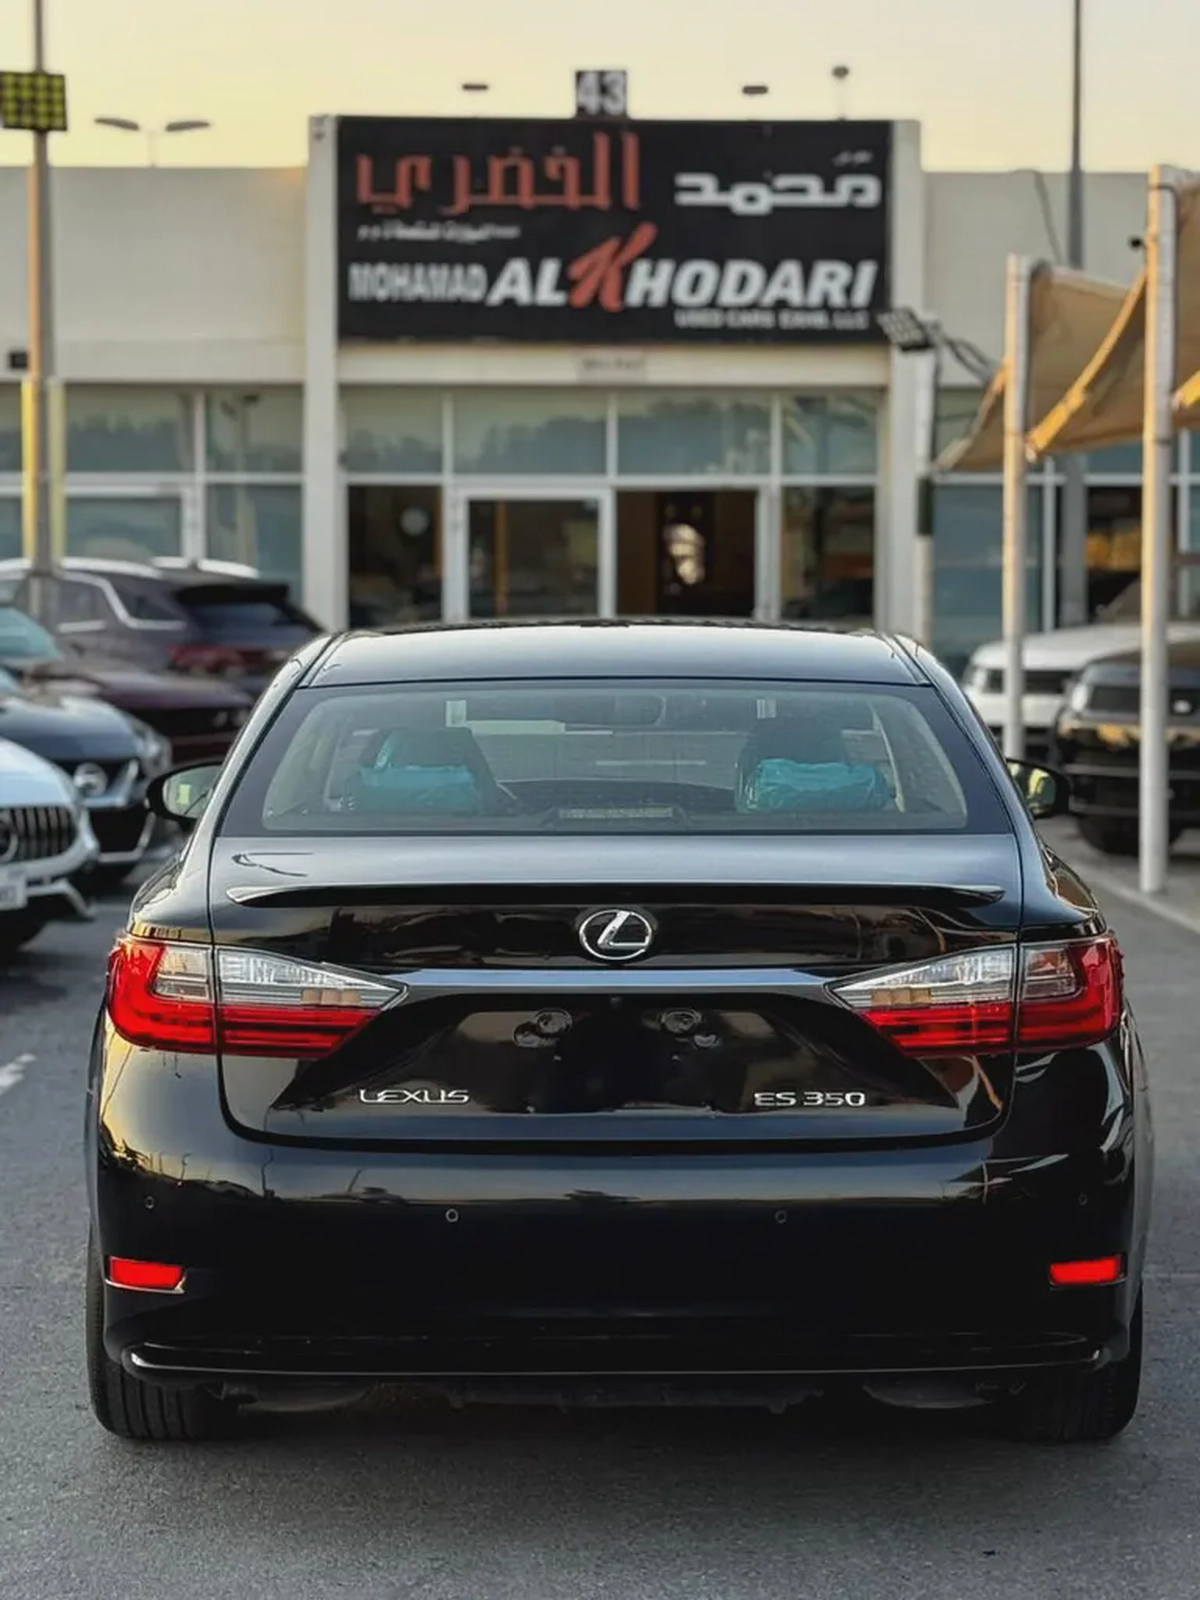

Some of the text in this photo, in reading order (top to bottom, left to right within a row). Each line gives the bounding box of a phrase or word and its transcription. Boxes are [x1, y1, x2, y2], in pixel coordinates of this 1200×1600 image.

[577, 72, 627, 115] 43
[674, 172, 882, 216] محمد
[359, 1089, 469, 1103] LEXUS
[754, 1091, 866, 1107] ES 350
